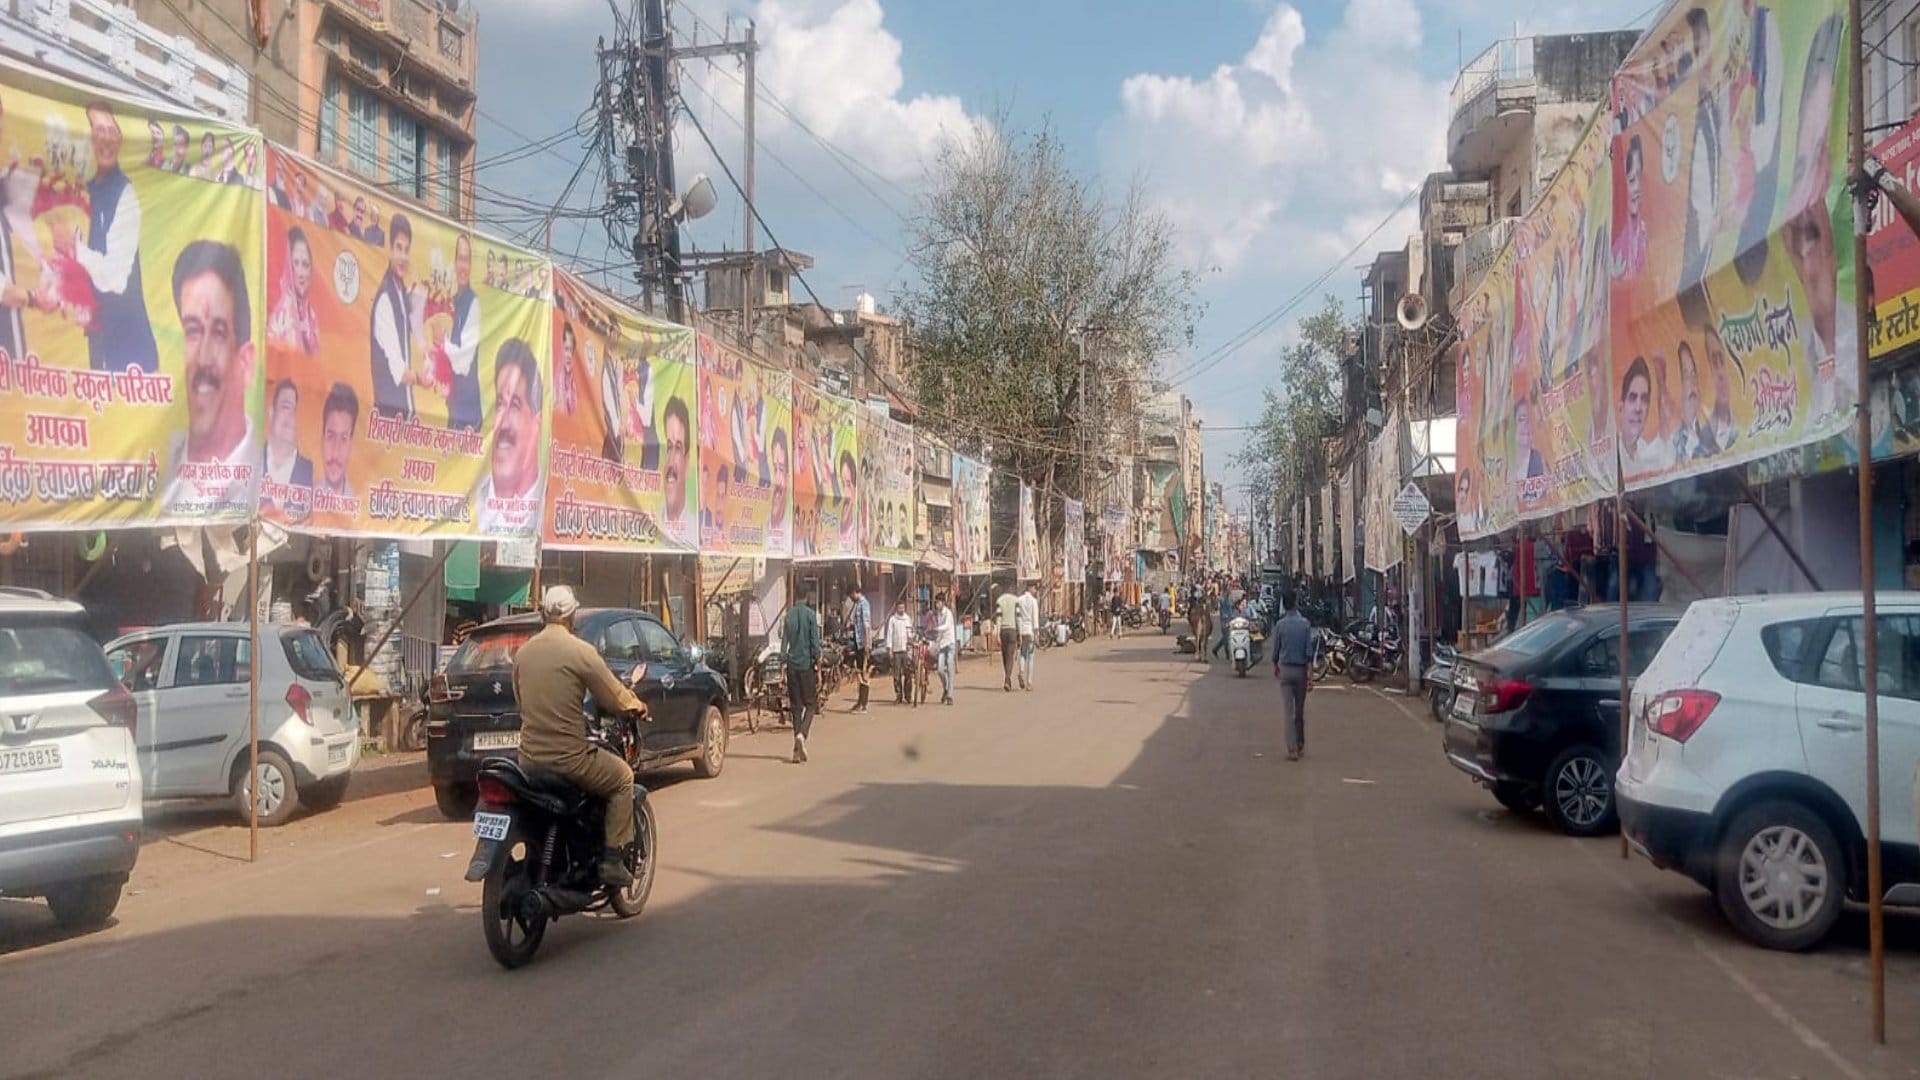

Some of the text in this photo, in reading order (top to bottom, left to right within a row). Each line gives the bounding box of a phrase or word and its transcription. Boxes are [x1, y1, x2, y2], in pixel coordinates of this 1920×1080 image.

[16, 354, 66, 397] पब्लिक
[73, 369, 112, 410] स्कूल
[117, 365, 172, 403] परिवार
[27, 413, 87, 447] अपका
[0, 447, 31, 506] र्दिक
[34, 461, 95, 498] स्वागत
[99, 463, 144, 499] करता
[401, 458, 437, 482] अपका
[369, 480, 399, 520] हार्दिक
[401, 490, 435, 519] स्वागत
